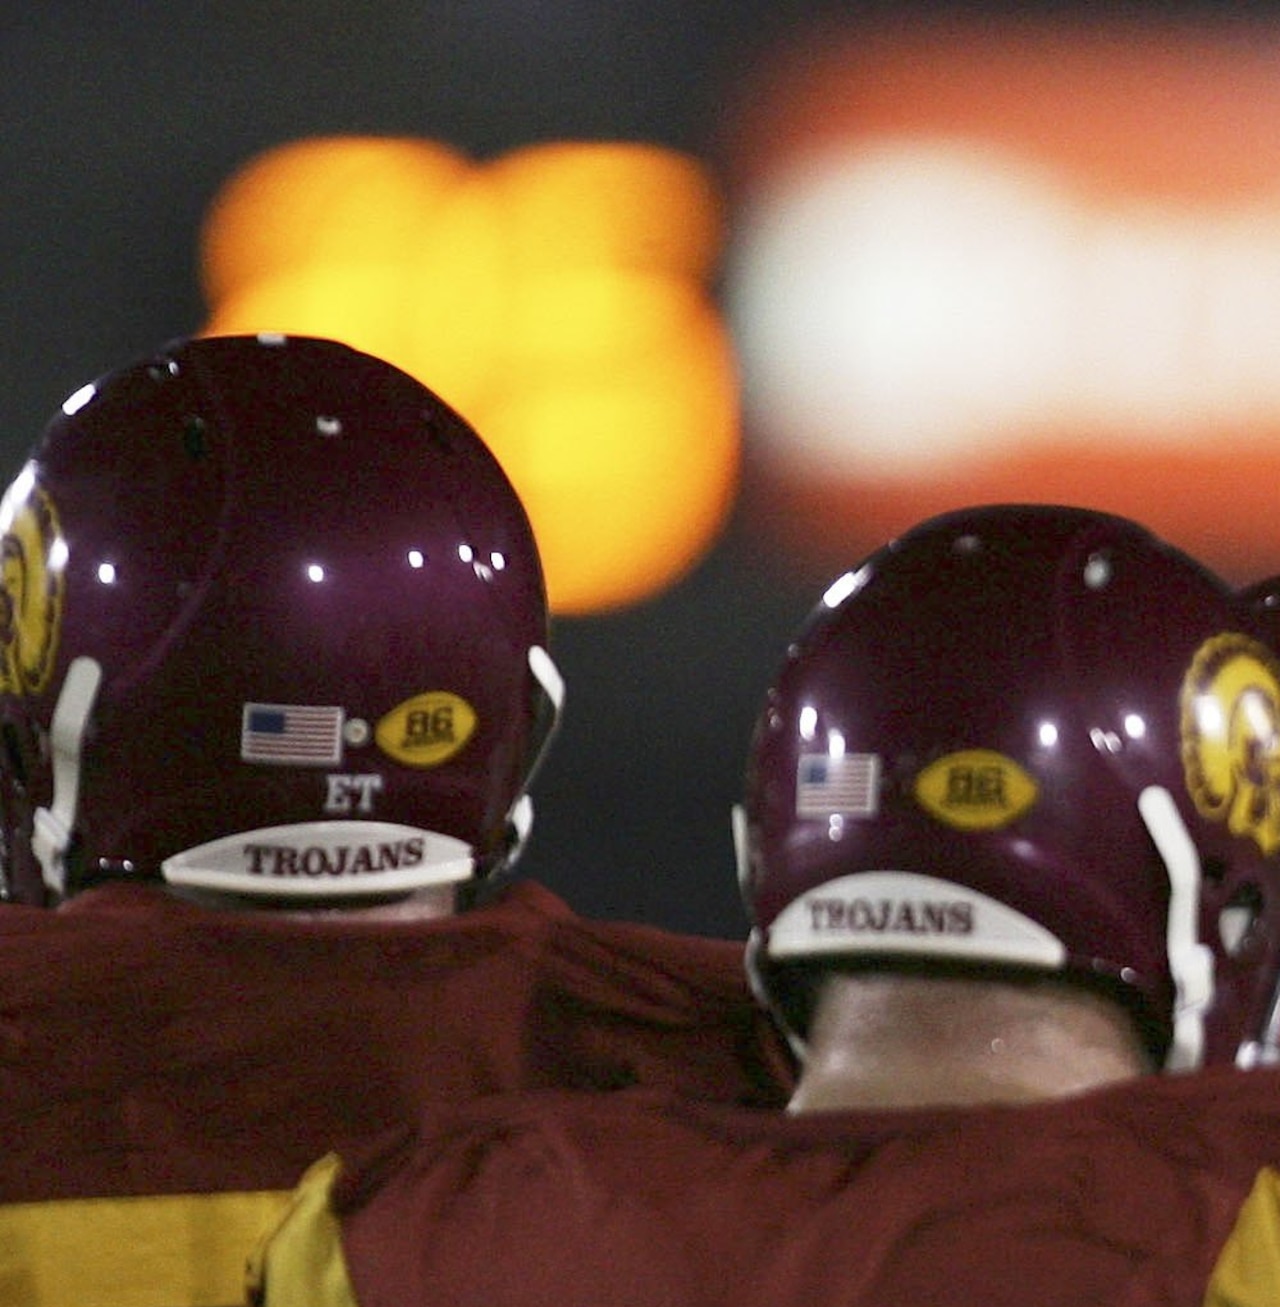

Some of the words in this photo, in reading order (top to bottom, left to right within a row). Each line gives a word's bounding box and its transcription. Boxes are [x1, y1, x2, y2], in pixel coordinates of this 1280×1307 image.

[406, 705, 454, 743] 86
[324, 773, 382, 812] ET
[244, 838, 425, 876] TROJANS
[807, 898, 973, 934] TROJANS
